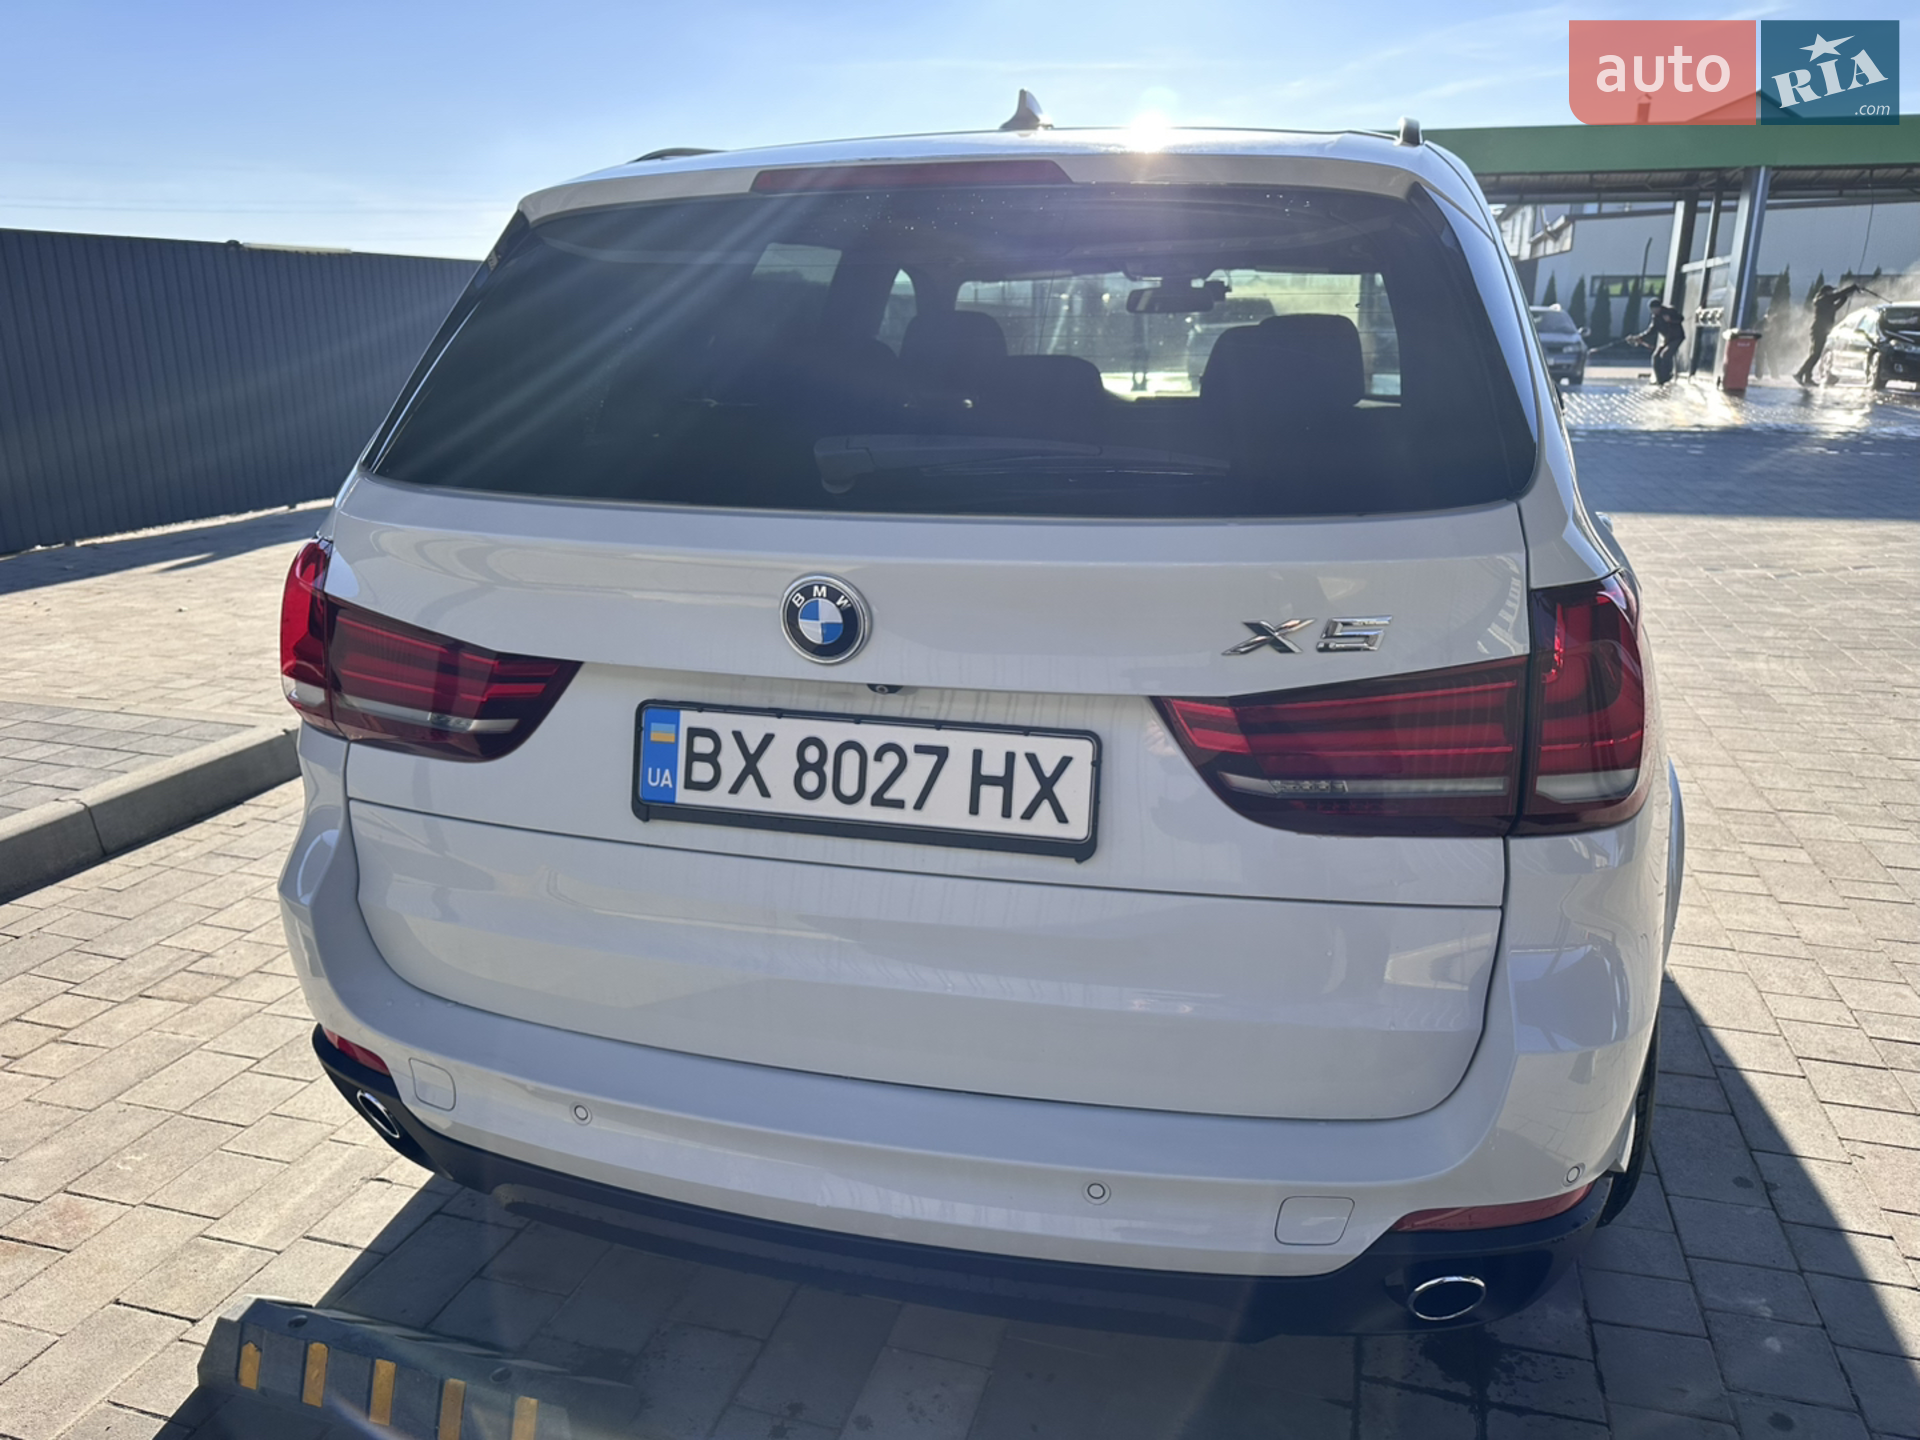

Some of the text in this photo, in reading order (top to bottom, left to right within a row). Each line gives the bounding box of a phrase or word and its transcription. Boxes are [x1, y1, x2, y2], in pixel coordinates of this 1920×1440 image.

[791, 585, 852, 610] BMW
[1221, 615, 1393, 656] X5
[647, 767, 673, 789] UA
[683, 726, 1073, 824] BX 8027 HX
